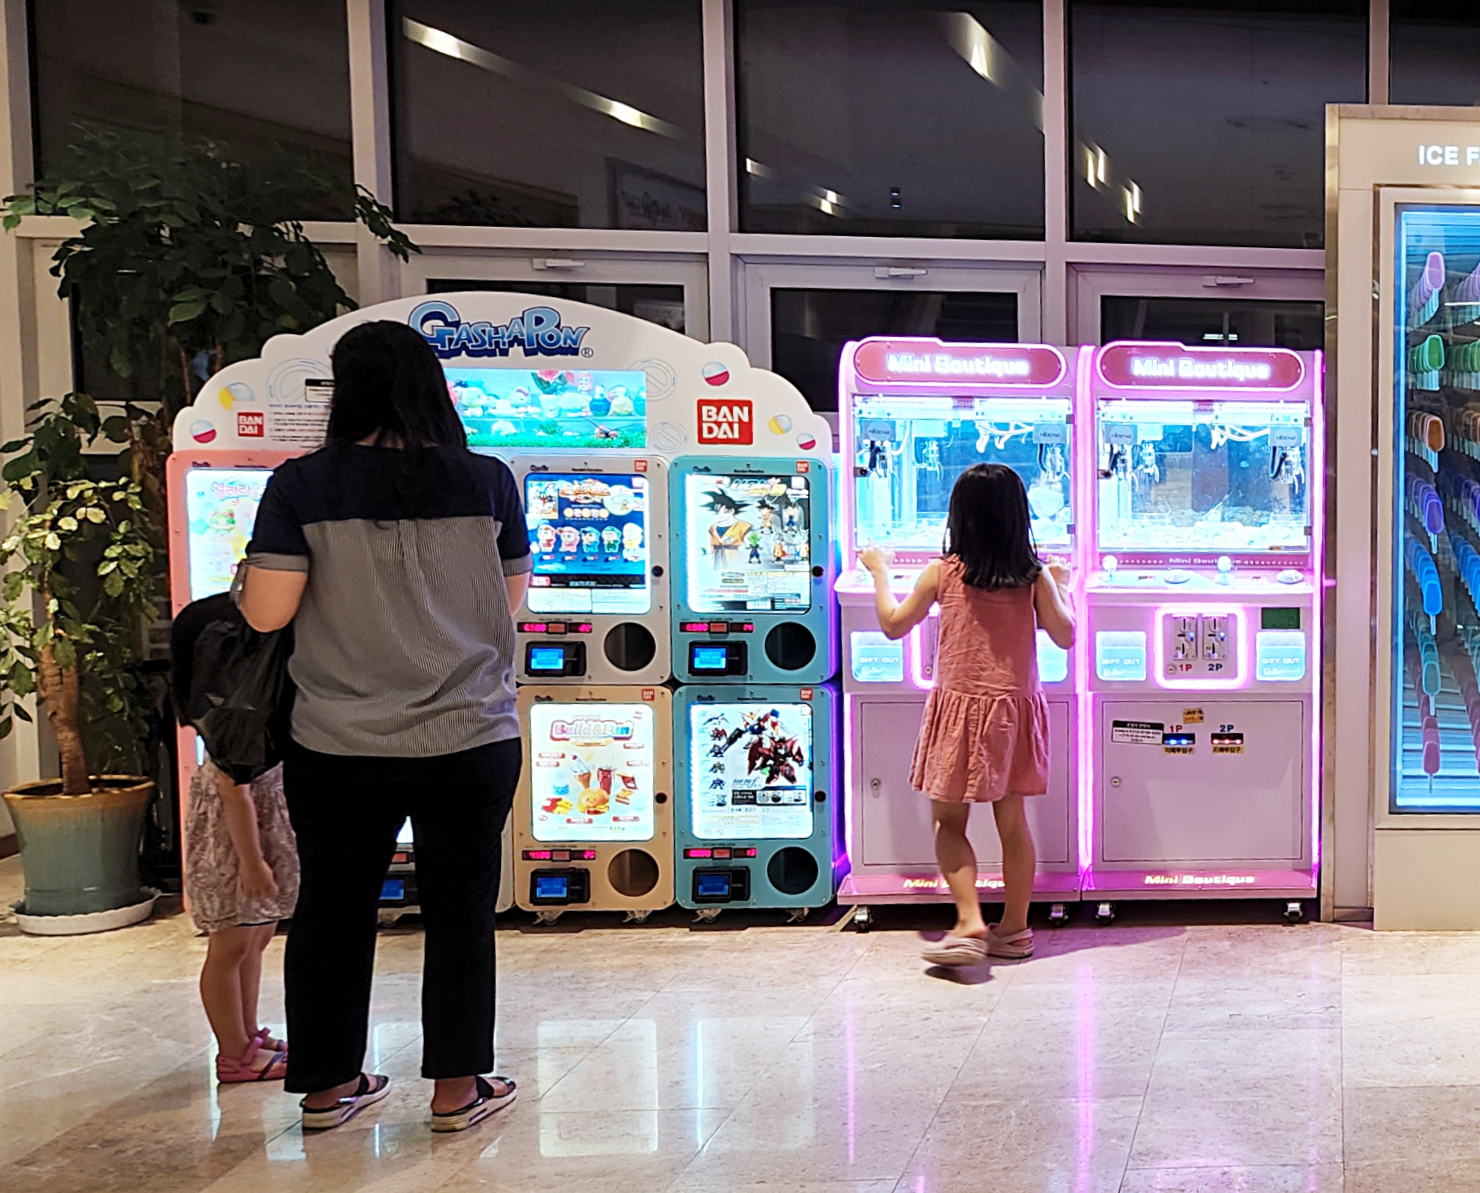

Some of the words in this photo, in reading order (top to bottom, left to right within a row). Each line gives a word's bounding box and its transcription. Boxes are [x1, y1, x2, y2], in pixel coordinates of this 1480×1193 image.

[1418, 145, 1459, 166] ICE
[888, 354, 932, 374] Mini
[935, 356, 1029, 378] Boutique
[1133, 358, 1174, 376] Mini
[1178, 360, 1269, 381] Boutique
[702, 405, 749, 423] BAN
[239, 415, 263, 425] BAN
[702, 423, 739, 439] DAI
[1178, 664, 1193, 672] 1P
[1207, 663, 1223, 672] 2P
[1169, 725, 1183, 733] 1P
[1219, 724, 1235, 732] 2P
[903, 879, 938, 888] Mini
[1144, 875, 1178, 884] Mini
[1182, 875, 1255, 885] Boutique
